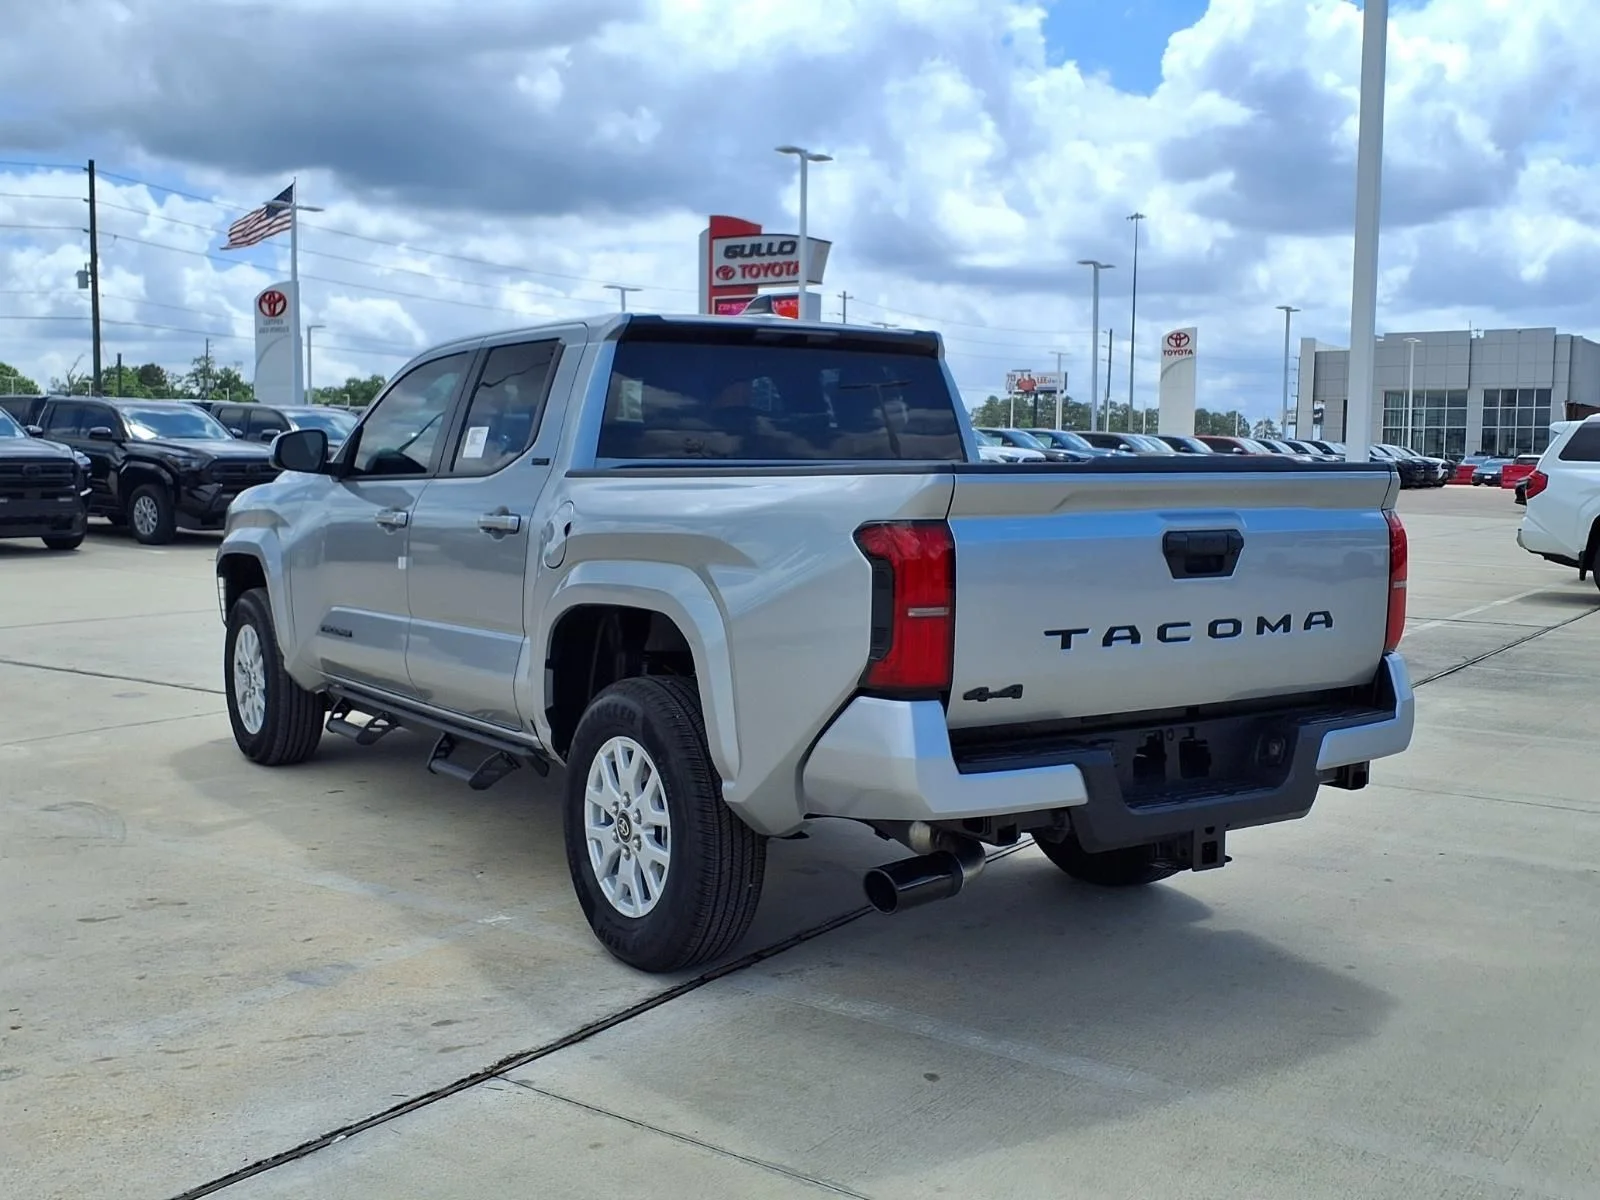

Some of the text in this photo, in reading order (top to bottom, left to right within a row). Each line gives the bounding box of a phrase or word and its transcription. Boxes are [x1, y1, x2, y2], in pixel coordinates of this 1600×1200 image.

[723, 240, 797, 259] GULLO
[738, 260, 799, 279] TOYOTA
[1044, 610, 1334, 650] TACOMA
